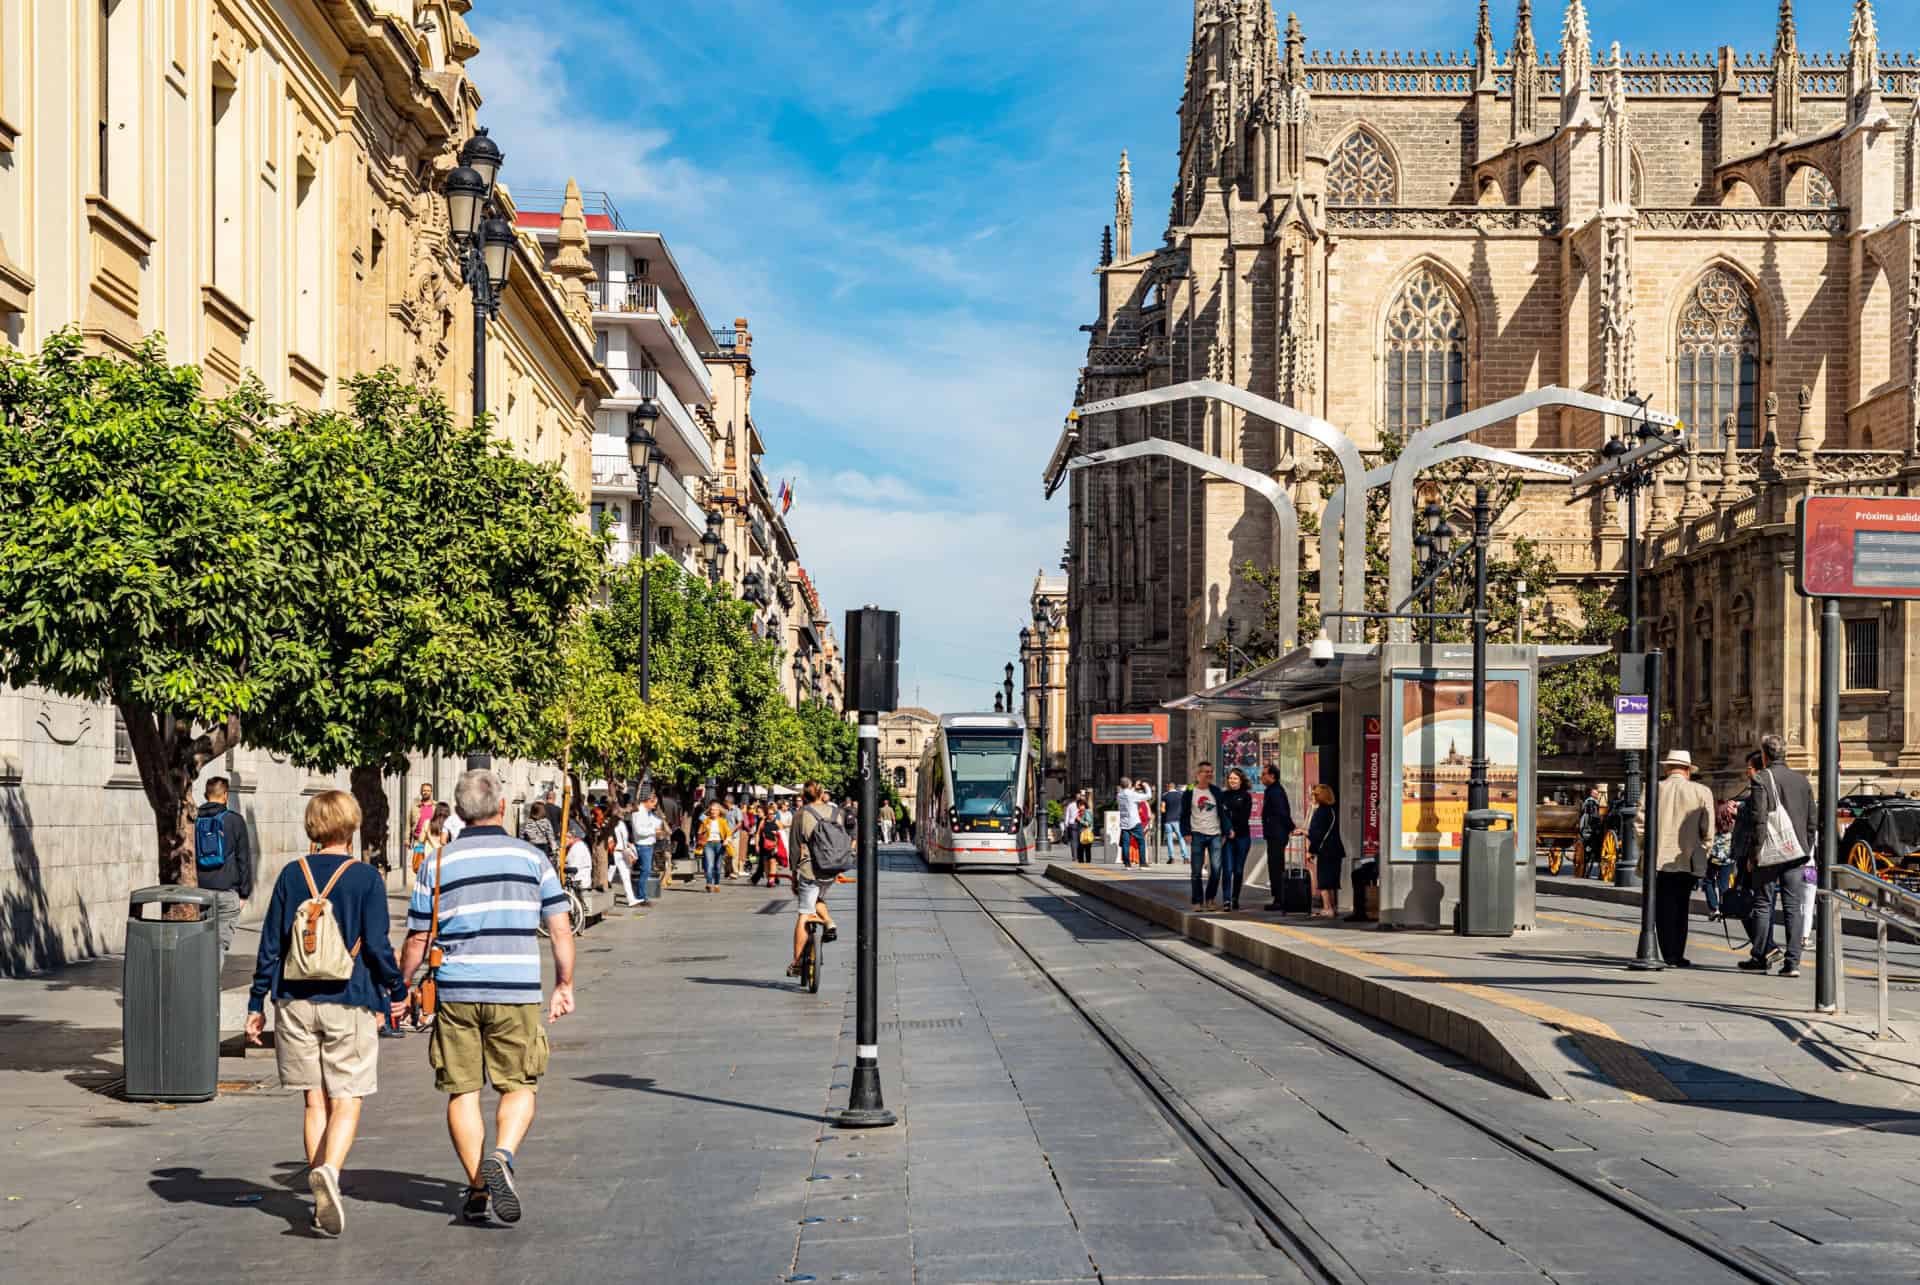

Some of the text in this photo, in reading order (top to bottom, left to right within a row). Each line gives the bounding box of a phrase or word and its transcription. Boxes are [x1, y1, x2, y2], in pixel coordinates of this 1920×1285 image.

[1855, 511, 1894, 521] Próxima
[1369, 752, 1378, 828] ARCHIVO DE INDIAS
